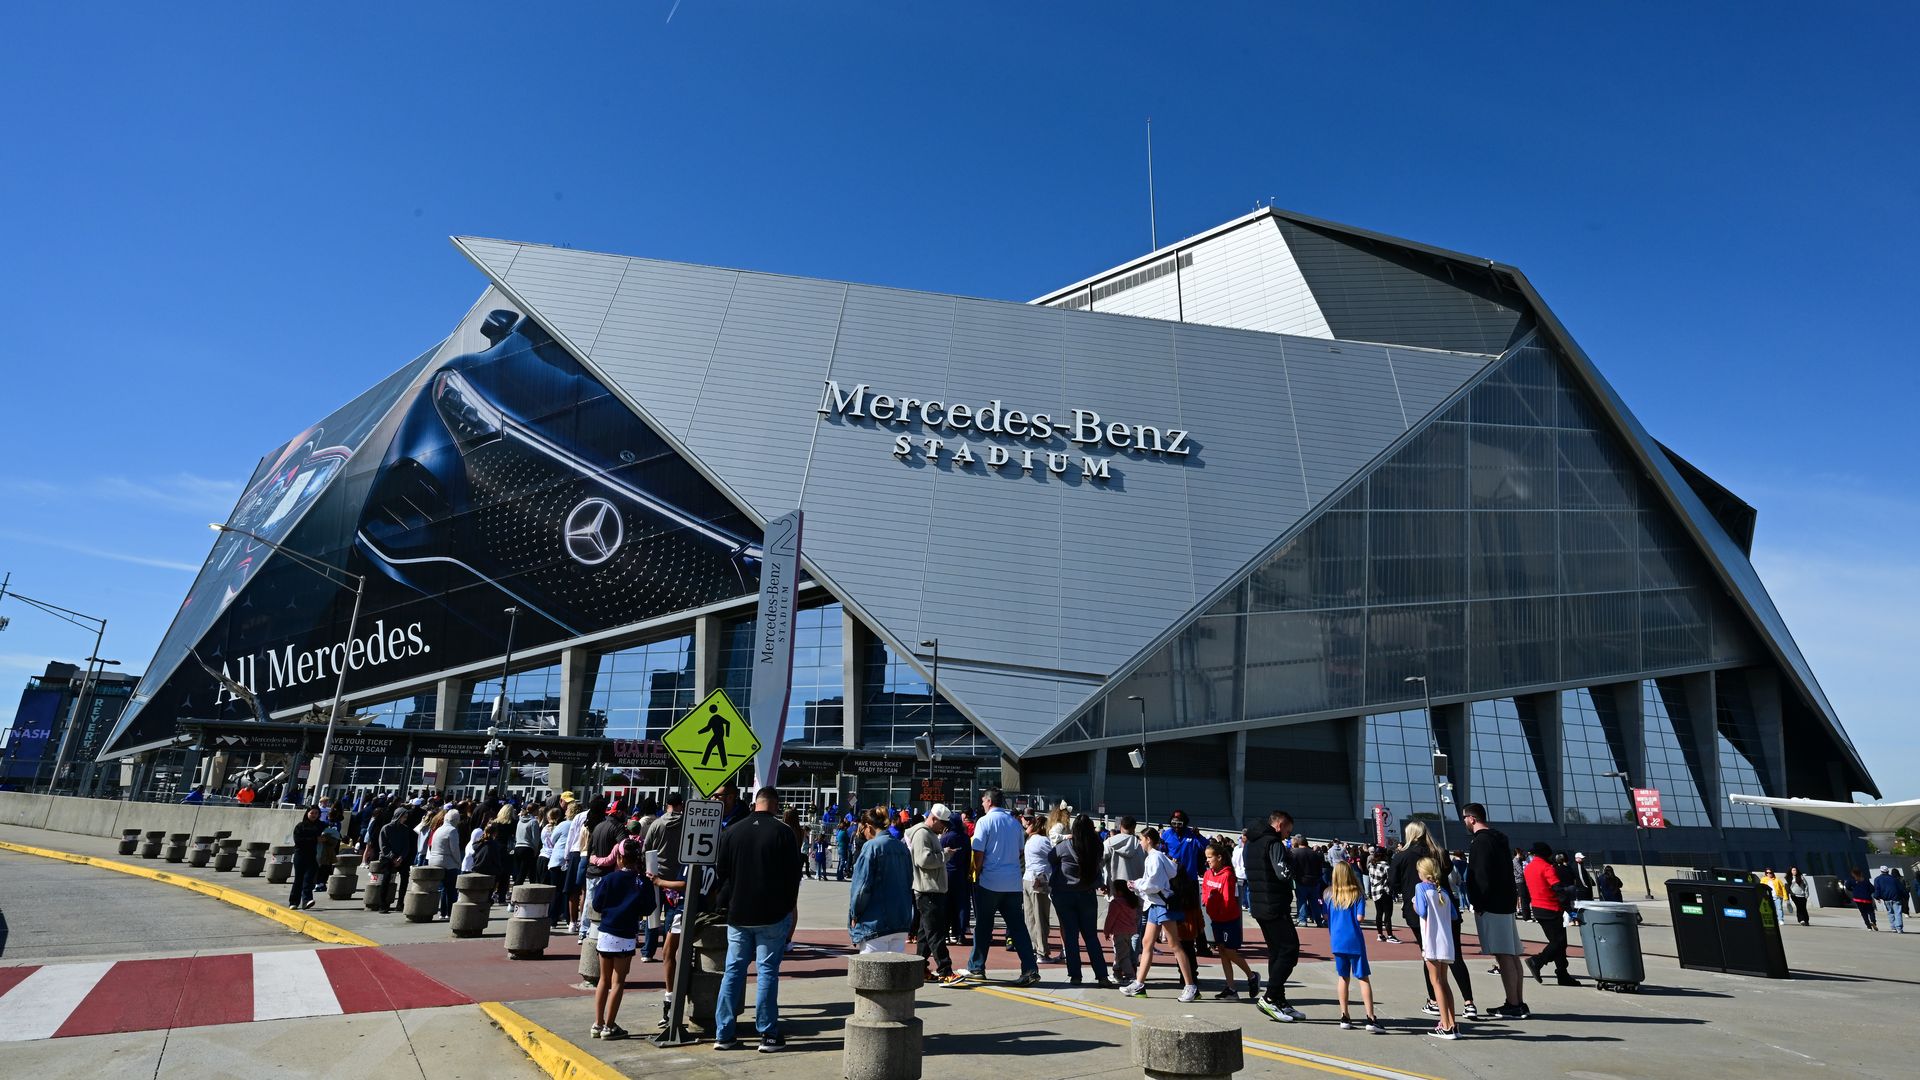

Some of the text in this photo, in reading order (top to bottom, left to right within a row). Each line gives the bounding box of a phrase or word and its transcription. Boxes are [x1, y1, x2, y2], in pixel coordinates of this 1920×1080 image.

[818, 380, 1190, 455] Mercedes-Benz
[893, 435, 1111, 479] STADIUM
[761, 562, 781, 665] Mercedes-Benz
[778, 585, 789, 643] STADIUM
[214, 619, 431, 706] All Mercedes.
[10, 729, 51, 739] NASH
[618, 757, 640, 765] READY
[648, 758, 666, 766] SCAN
[688, 807, 720, 817] SPEED
[690, 818, 716, 828] LIMIT
[687, 833, 714, 857] 15
